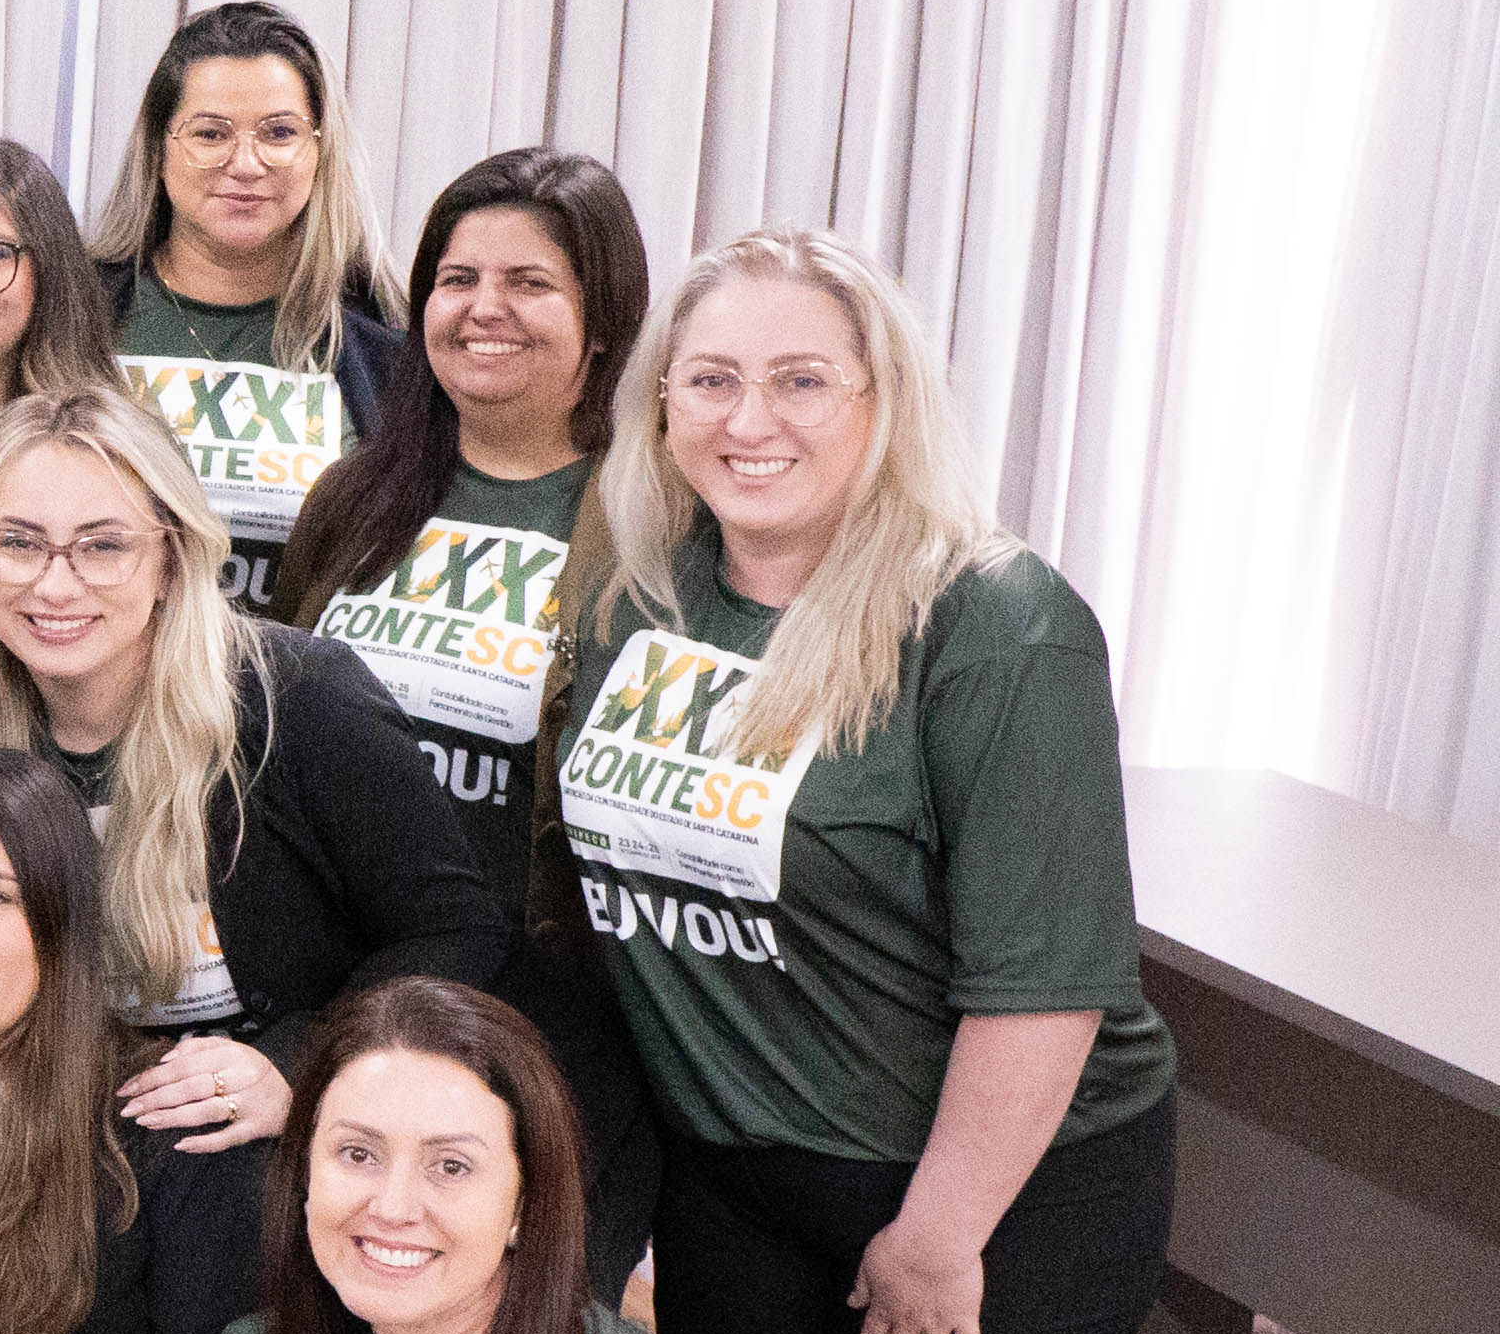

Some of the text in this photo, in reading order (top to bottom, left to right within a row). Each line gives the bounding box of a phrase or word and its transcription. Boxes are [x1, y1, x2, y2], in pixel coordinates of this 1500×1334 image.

[320, 603, 543, 676] CONTESC
[567, 738, 770, 829] CONTESC
[580, 876, 786, 971] EU VOU!
